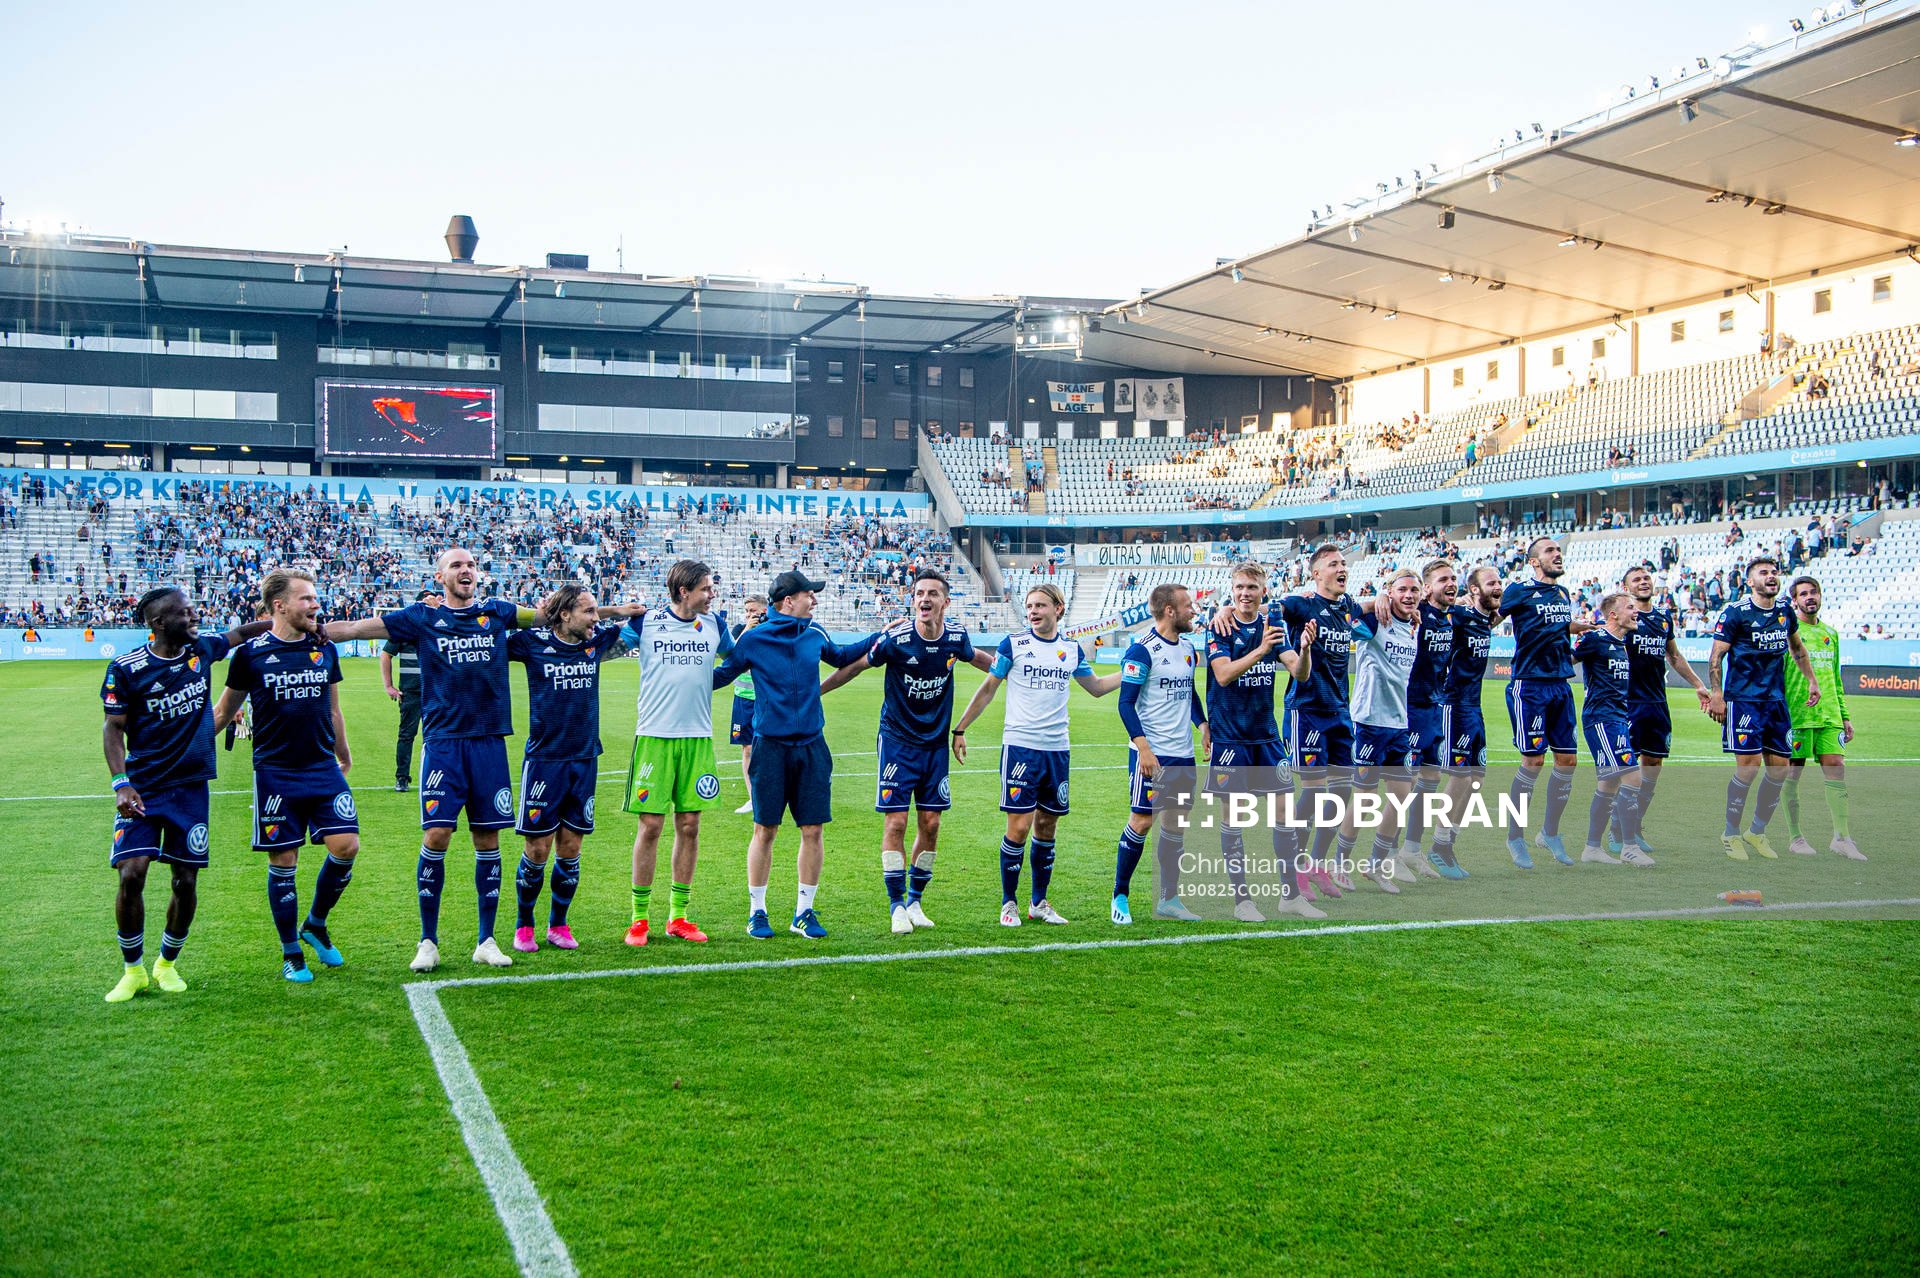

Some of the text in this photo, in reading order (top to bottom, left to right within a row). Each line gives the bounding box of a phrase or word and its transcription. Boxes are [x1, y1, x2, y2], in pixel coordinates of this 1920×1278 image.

[1058, 403, 1095, 412] LAGET
[79, 471, 144, 500] FÖR
[757, 494, 819, 516] INTE
[826, 496, 909, 518] FALLA
[1099, 545, 1142, 566] ØLTRAS
[1536, 602, 1571, 615] Priorite
[1544, 613, 1571, 624] Finans
[1424, 629, 1453, 641] Priorite
[1632, 634, 1667, 646] Priorite
[436, 634, 495, 652] Prioritet
[653, 640, 710, 653] Prioritet
[1384, 641, 1417, 657] Priorite
[447, 649, 491, 664] Finans
[662, 652, 703, 666] Finans
[544, 661, 597, 678] Prioritet
[263, 669, 329, 688] Prioritet
[553, 676, 592, 690] Finans
[1030, 677, 1066, 692] Finans
[1160, 675, 1193, 689] Priorit
[147, 676, 208, 713] Prioritet
[275, 685, 322, 701] Finans
[908, 686, 943, 700] Finans
[1166, 688, 1193, 701] Finan
[159, 696, 204, 721] Finans
